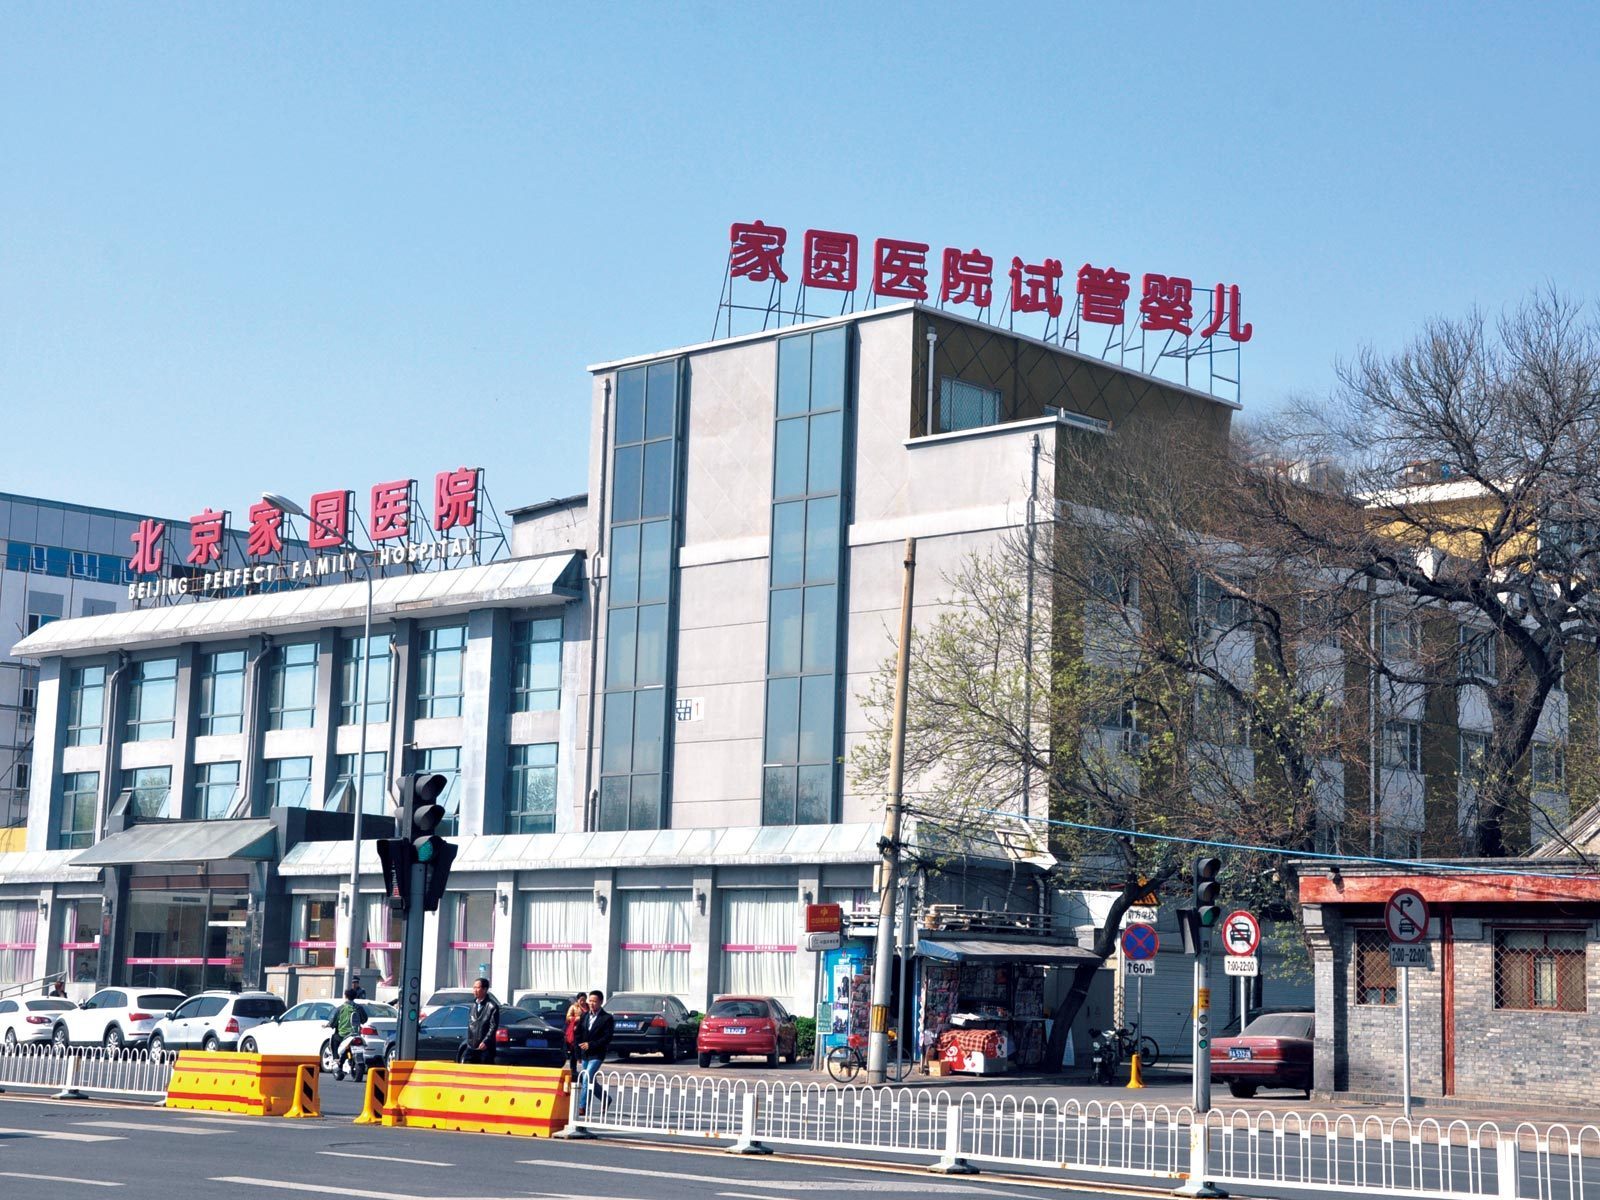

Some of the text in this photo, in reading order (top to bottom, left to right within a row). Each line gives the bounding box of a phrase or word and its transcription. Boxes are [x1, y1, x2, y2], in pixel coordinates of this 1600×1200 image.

[730, 219, 1253, 342] 家圆医院试管婴儿
[129, 466, 479, 574] 北京家圆医院
[128, 536, 475, 600] BEIJING PERFECT FAMILY HOSPITAL
[1227, 960, 1255, 972] 7:00-22:00
[1391, 947, 1425, 963] 7:00-22:00
